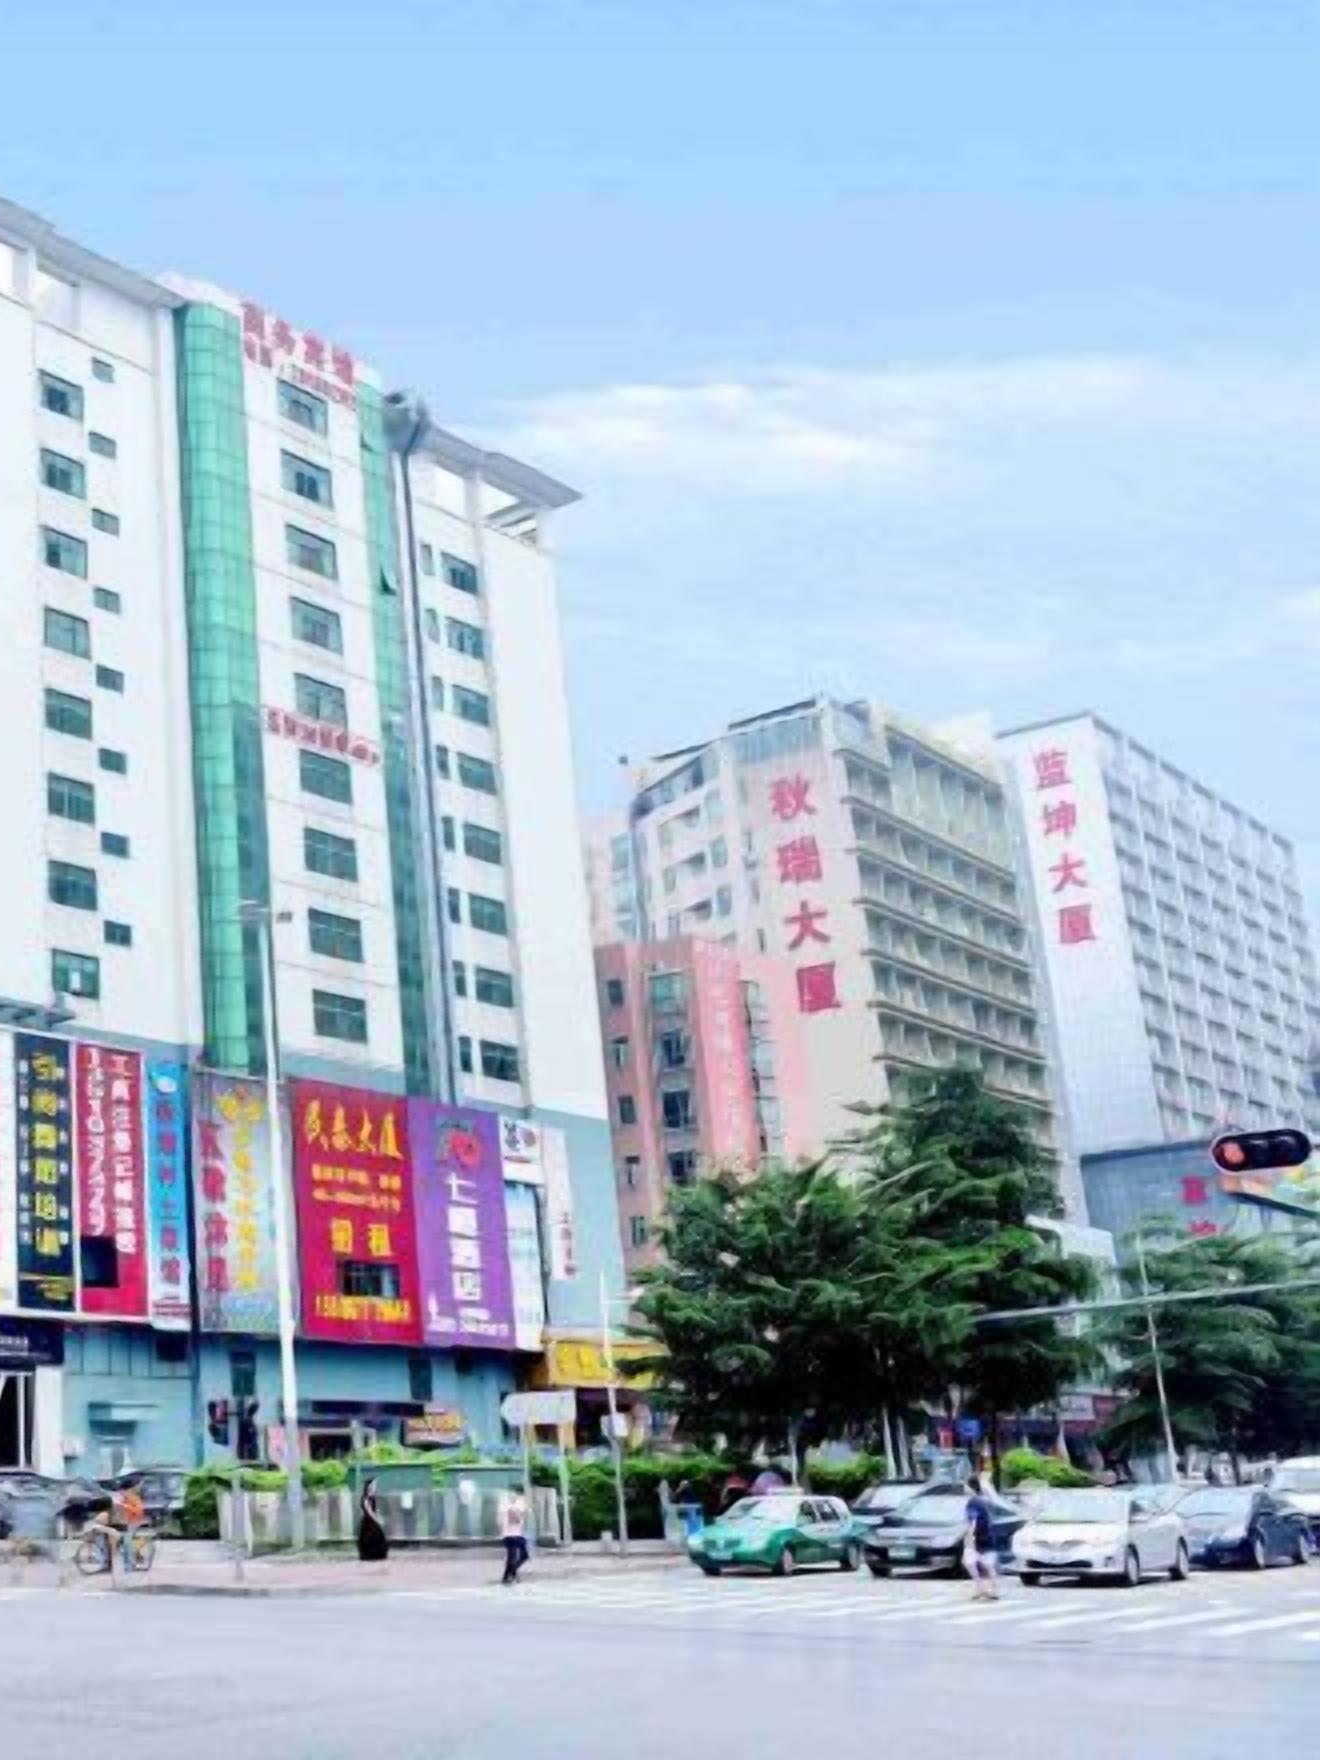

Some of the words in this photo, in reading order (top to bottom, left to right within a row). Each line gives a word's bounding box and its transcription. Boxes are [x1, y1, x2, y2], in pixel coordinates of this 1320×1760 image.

[770, 772, 842, 1015] 秋瑞大厦
[1033, 749, 1096, 944] 蓝坤大厦
